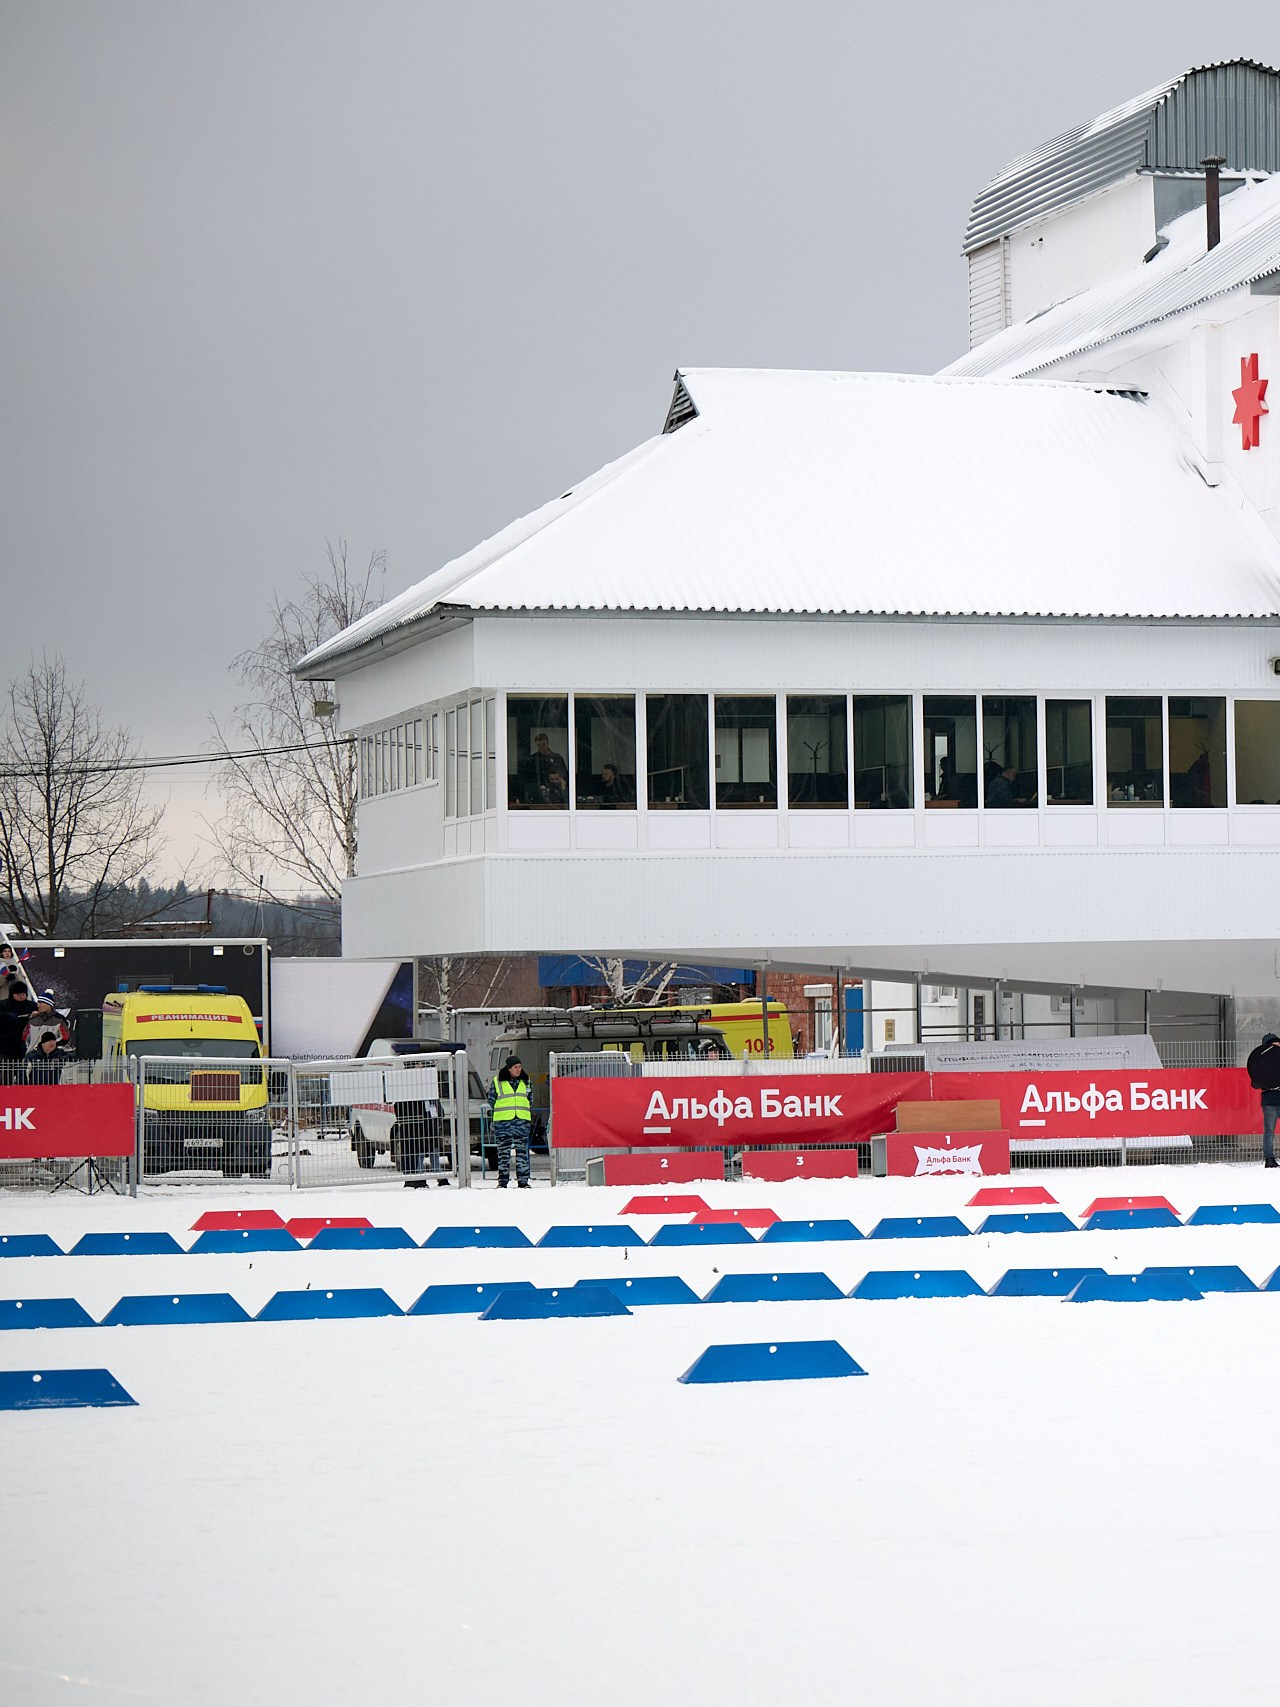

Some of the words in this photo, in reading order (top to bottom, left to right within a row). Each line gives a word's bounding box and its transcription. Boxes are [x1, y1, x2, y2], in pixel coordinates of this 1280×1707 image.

[151, 1014, 229, 1022] РЕАНИМАЦИЯ
[1020, 1083, 1123, 1119] Альфа
[1130, 1082, 1208, 1111] Банк
[644, 1089, 754, 1127] Альфа
[760, 1088, 844, 1118] Банк
[945, 1135, 951, 1145] 1
[660, 1158, 668, 1168] 2
[796, 1156, 804, 1166] 3
[926, 1156, 951, 1165] Альфа
